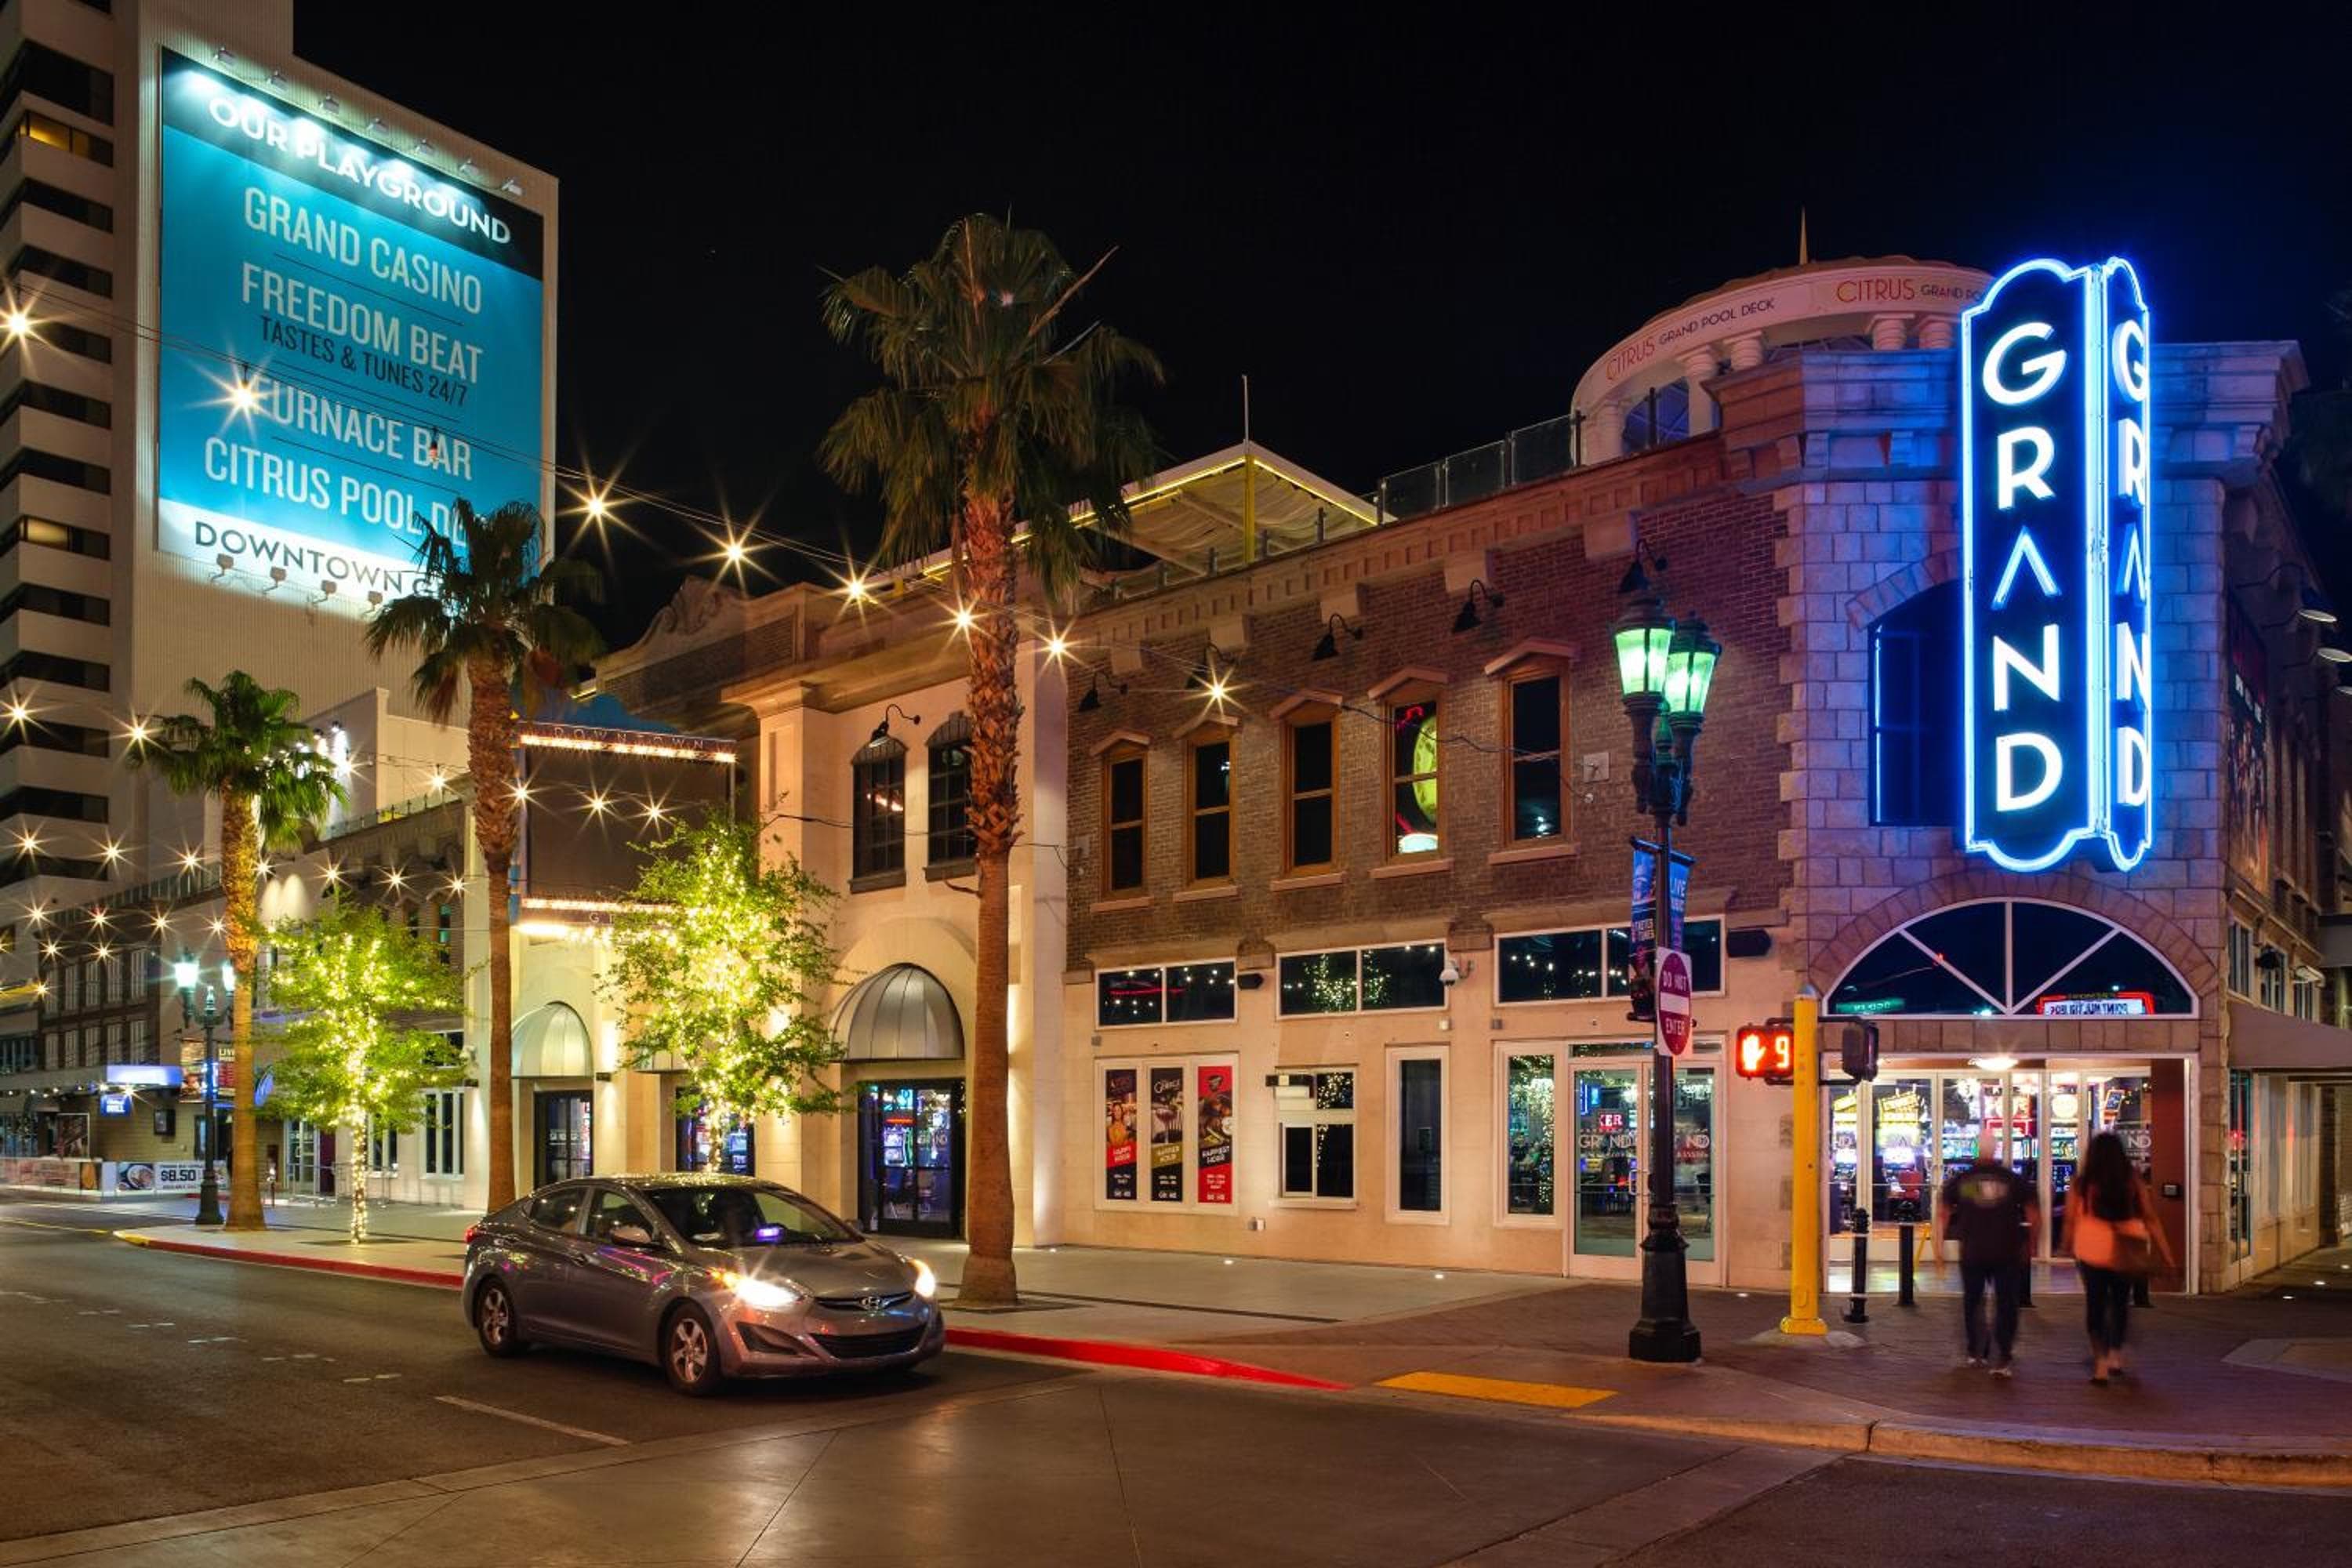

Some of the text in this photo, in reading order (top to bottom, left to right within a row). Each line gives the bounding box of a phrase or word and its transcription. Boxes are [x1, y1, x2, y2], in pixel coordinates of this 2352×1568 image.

[209, 96, 511, 245] OUR PLAYGROUND
[244, 187, 482, 314] GRAND CASINO
[1836, 278, 1916, 303] CITRUS
[1920, 284, 1962, 300] GRAND
[242, 261, 484, 384] FREEDOM BEAT
[260, 315, 468, 408] TASTES & TUNES 24/7
[1606, 298, 1775, 381] CITRUS GRAND POOL DECK
[252, 373, 473, 481] FURNACE BAR
[205, 437, 469, 547] CITRUS POOL DE
[194, 521, 404, 593] DOWNTOWN
[1981, 321, 2068, 813] GRAND
[2111, 318, 2151, 808] GRAND
[1663, 971, 1686, 993] DO NOT
[1666, 1017, 1686, 1036] ENTER
[1775, 1035, 1790, 1069] 9
[161, 1168, 196, 1181] $8.50
